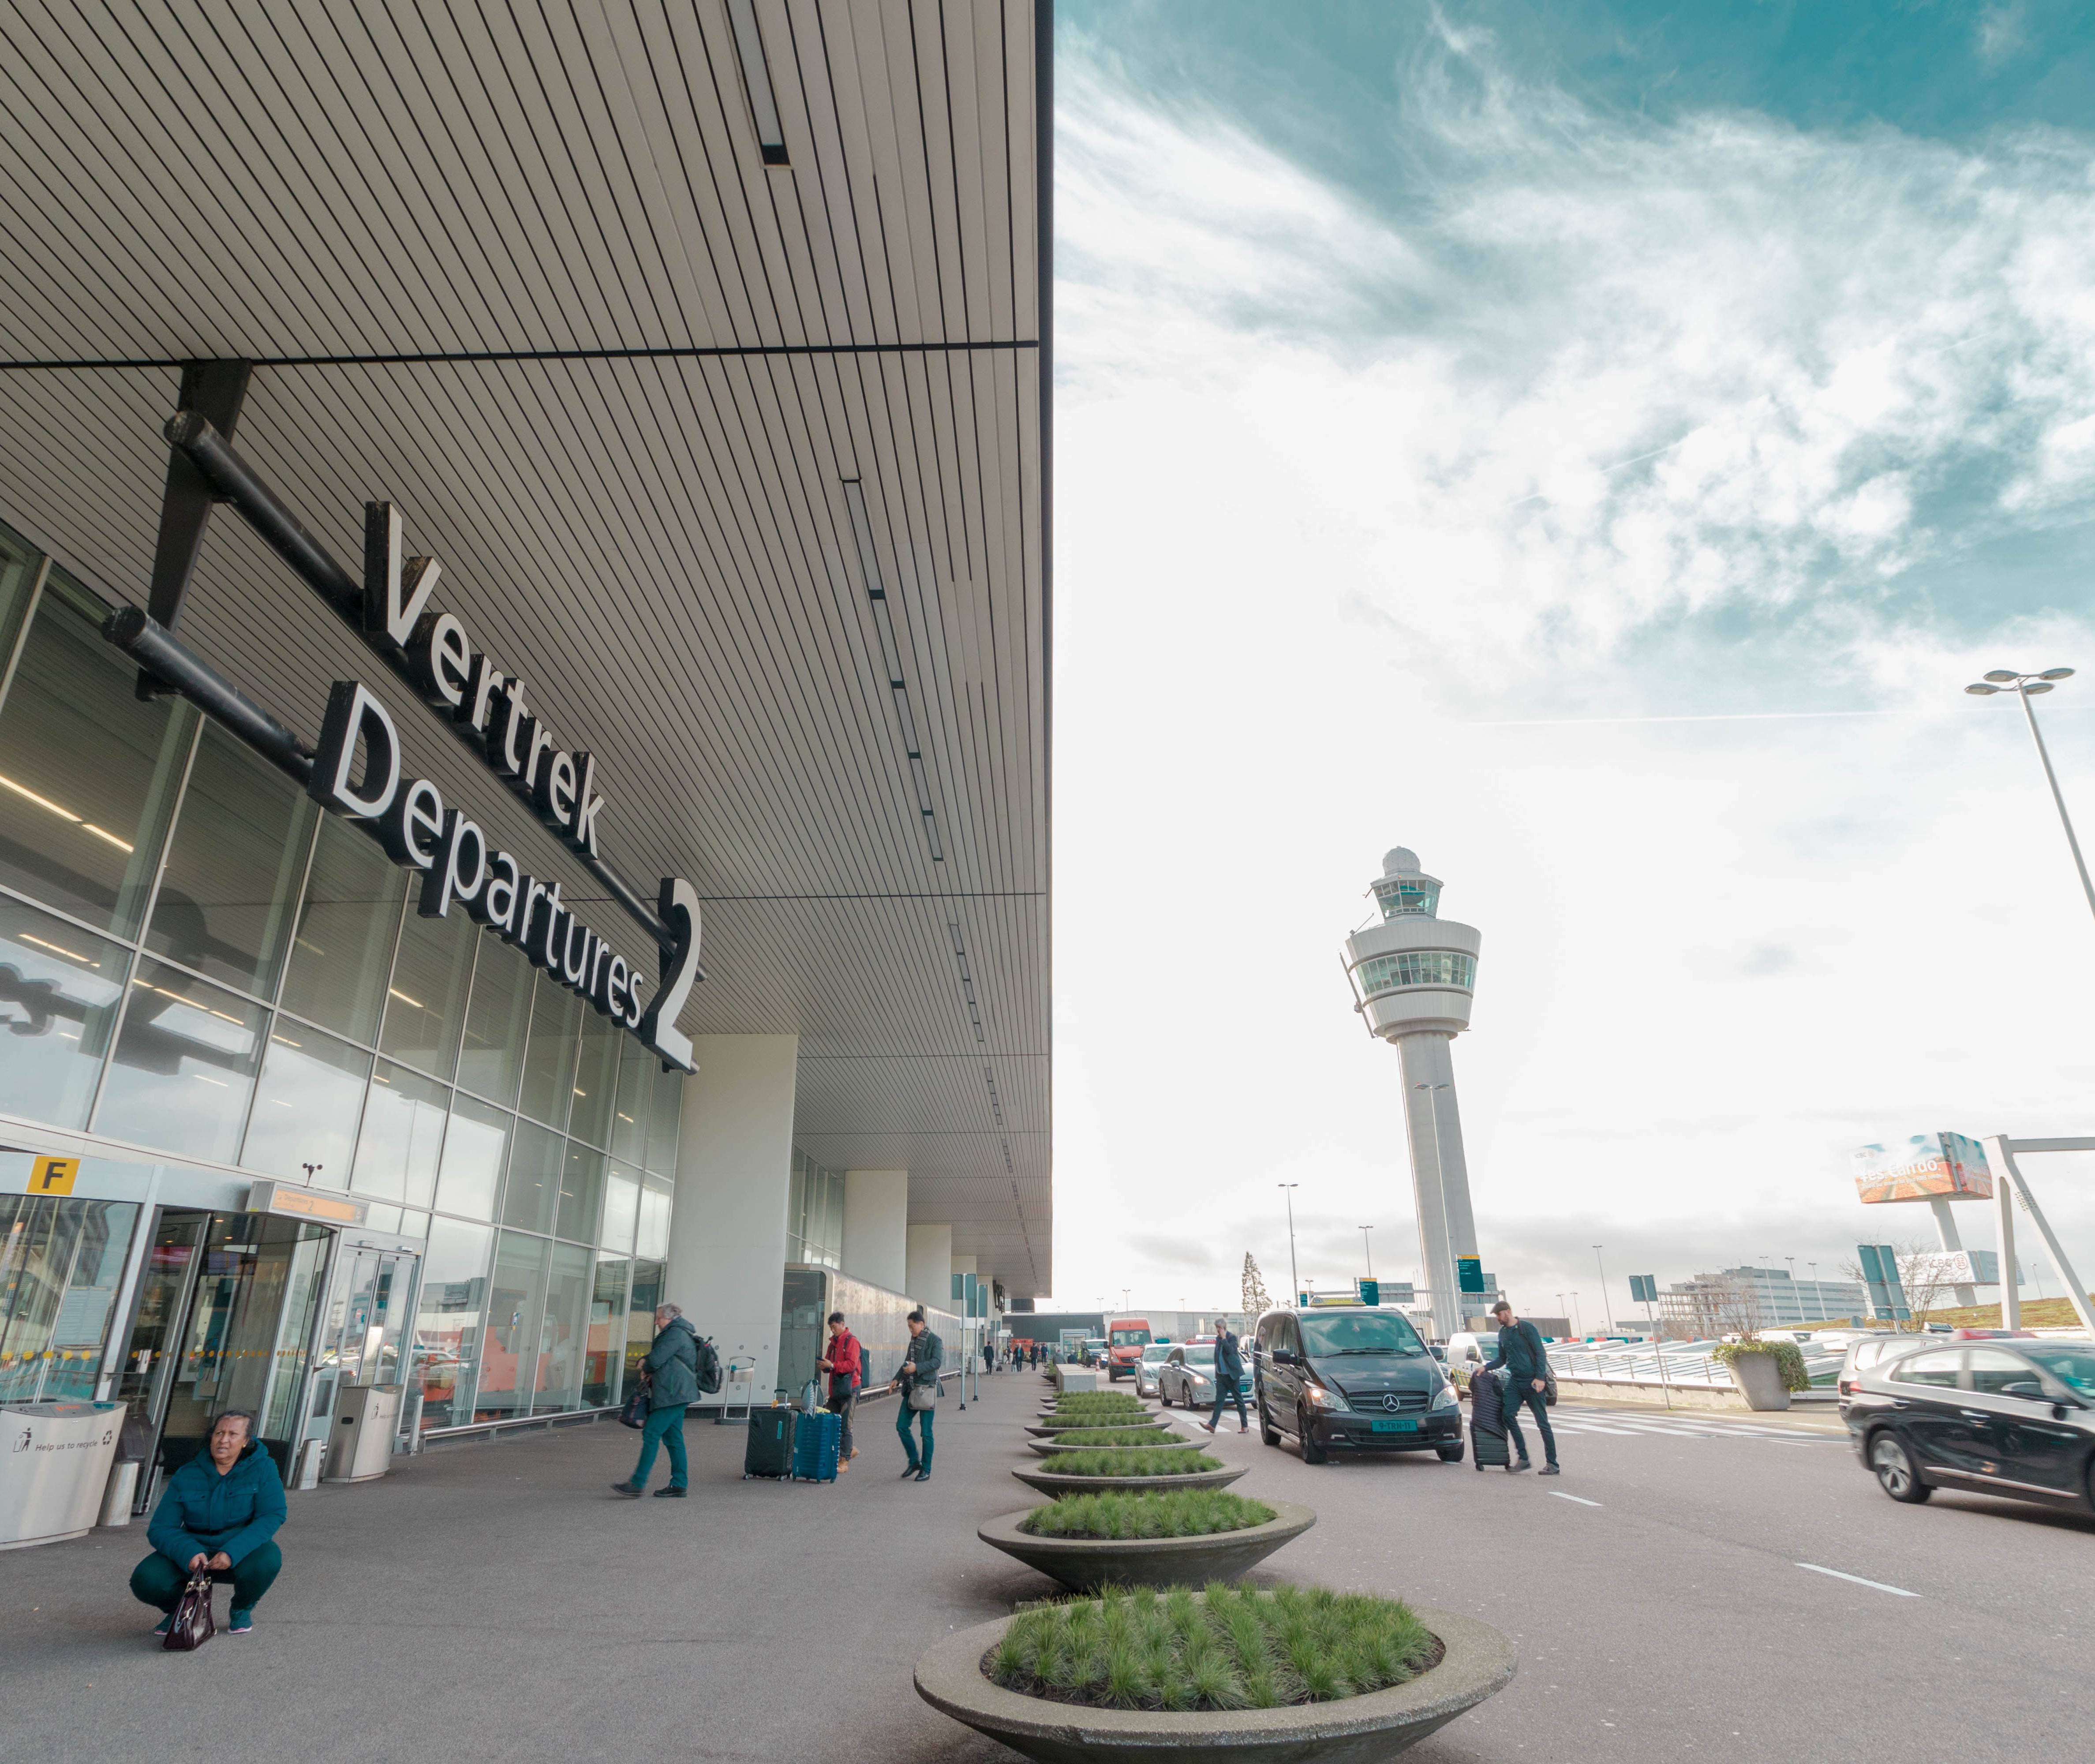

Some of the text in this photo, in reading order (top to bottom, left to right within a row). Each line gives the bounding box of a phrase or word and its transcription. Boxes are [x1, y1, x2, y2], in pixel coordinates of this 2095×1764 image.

[379, 501, 604, 859] Vertrek
[326, 681, 702, 1069] Departures 2
[42, 1162, 67, 1189] F
[35, 1443, 54, 1452] Help
[76, 1439, 98, 1450] recycle
